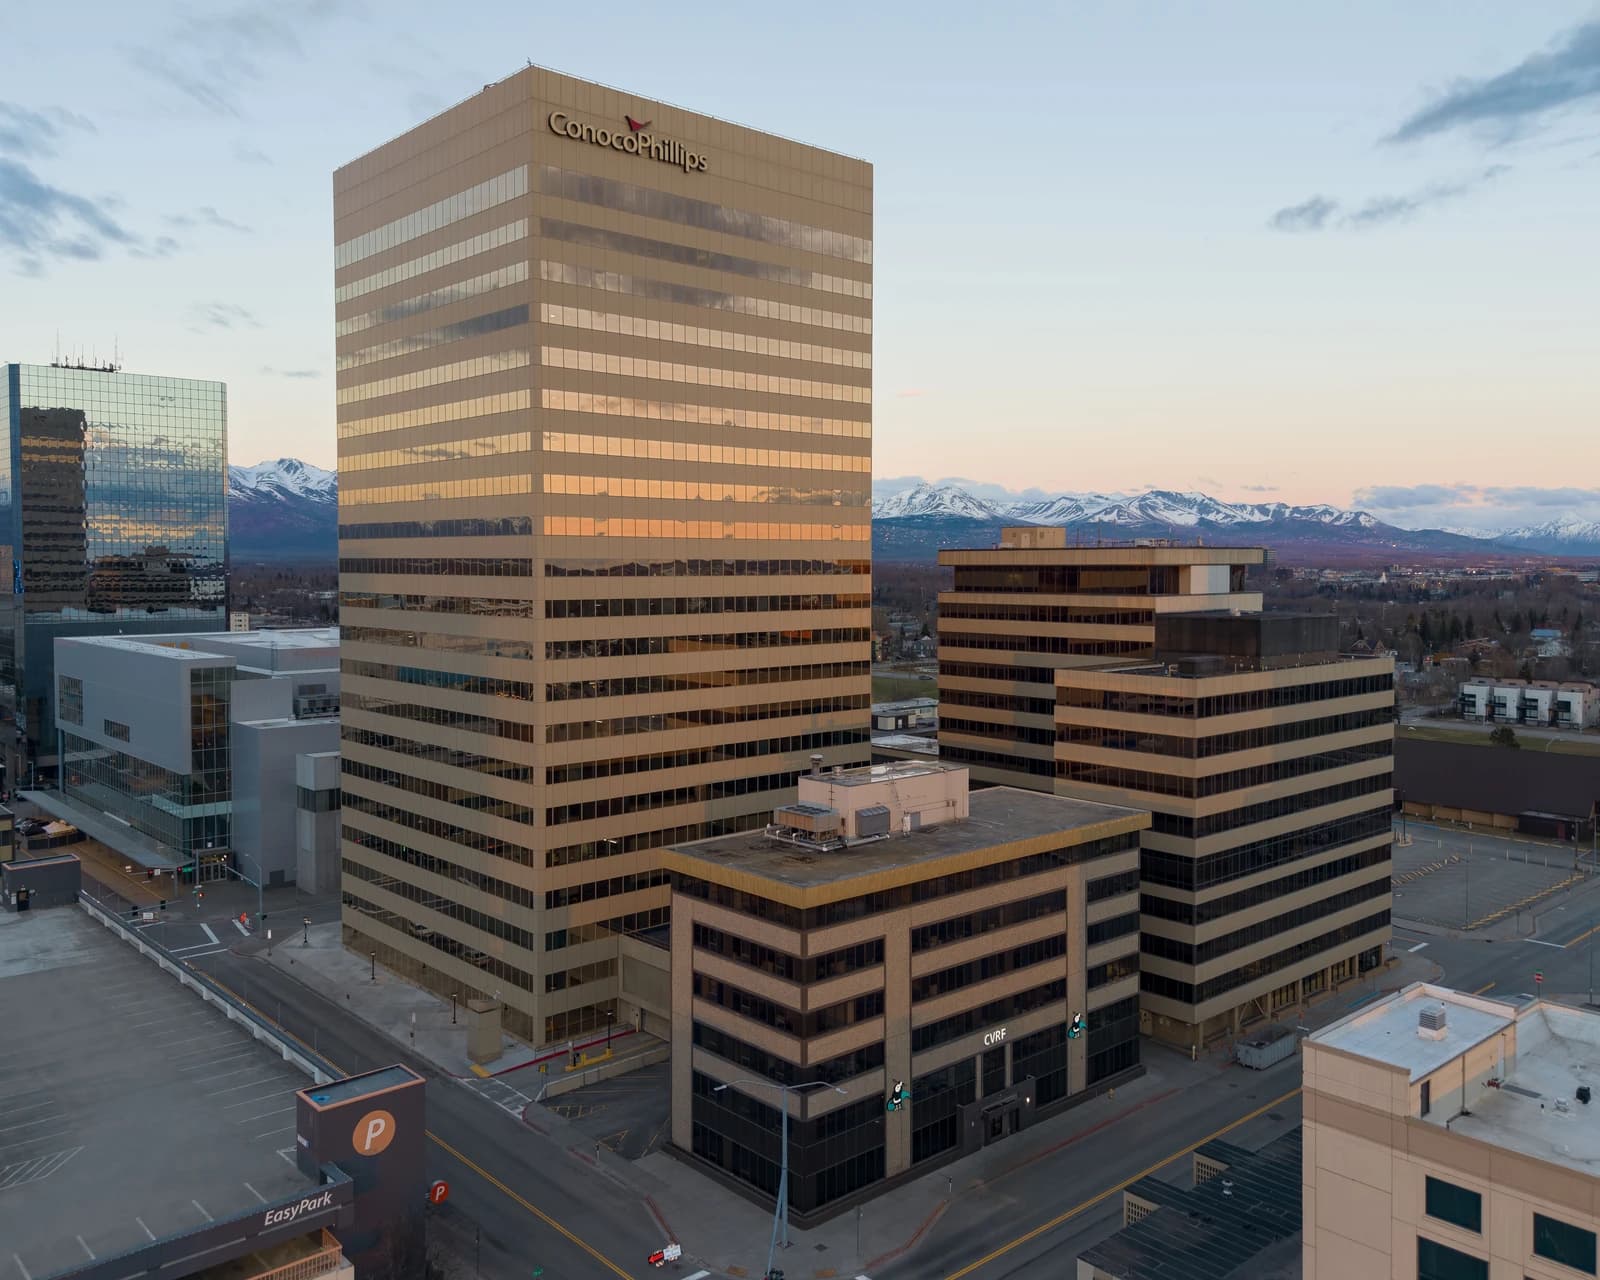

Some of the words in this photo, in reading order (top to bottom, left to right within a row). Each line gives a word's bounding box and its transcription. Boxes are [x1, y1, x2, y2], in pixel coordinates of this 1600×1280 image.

[549, 111, 708, 173] ConocoPhillips
[983, 1027, 1007, 1046] CVRF
[364, 1118, 386, 1150] P
[264, 1191, 333, 1226] EasyPark
[434, 1185, 446, 1201] P
